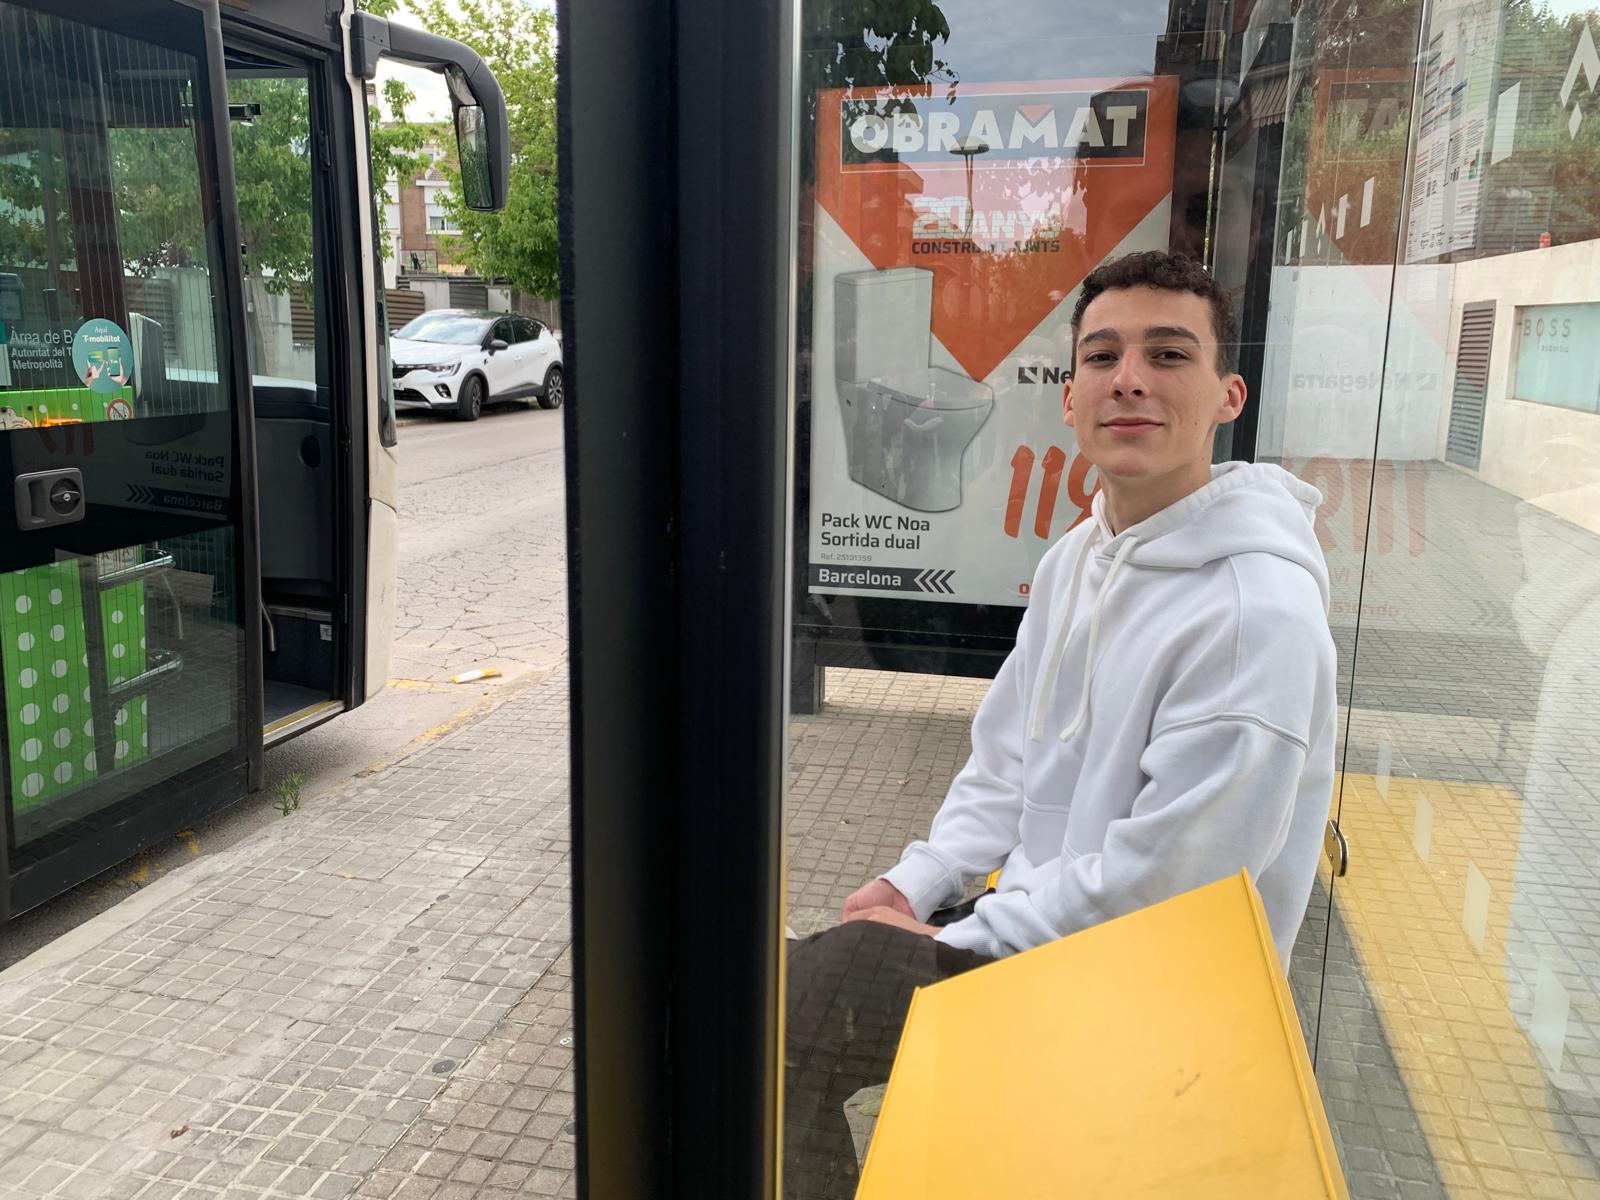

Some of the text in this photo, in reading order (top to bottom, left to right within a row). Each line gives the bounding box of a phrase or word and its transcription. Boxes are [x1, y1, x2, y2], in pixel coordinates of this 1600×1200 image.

[849, 104, 1138, 155] OBRAMAT
[43, 328, 60, 345] de
[1522, 317, 1572, 338] BOSS
[11, 346, 50, 358] Autoritat
[52, 346, 65, 357] del
[821, 512, 930, 531] Pack WC Noa
[821, 531, 920, 550] Sortida dual
[818, 568, 902, 587] Barcelona
